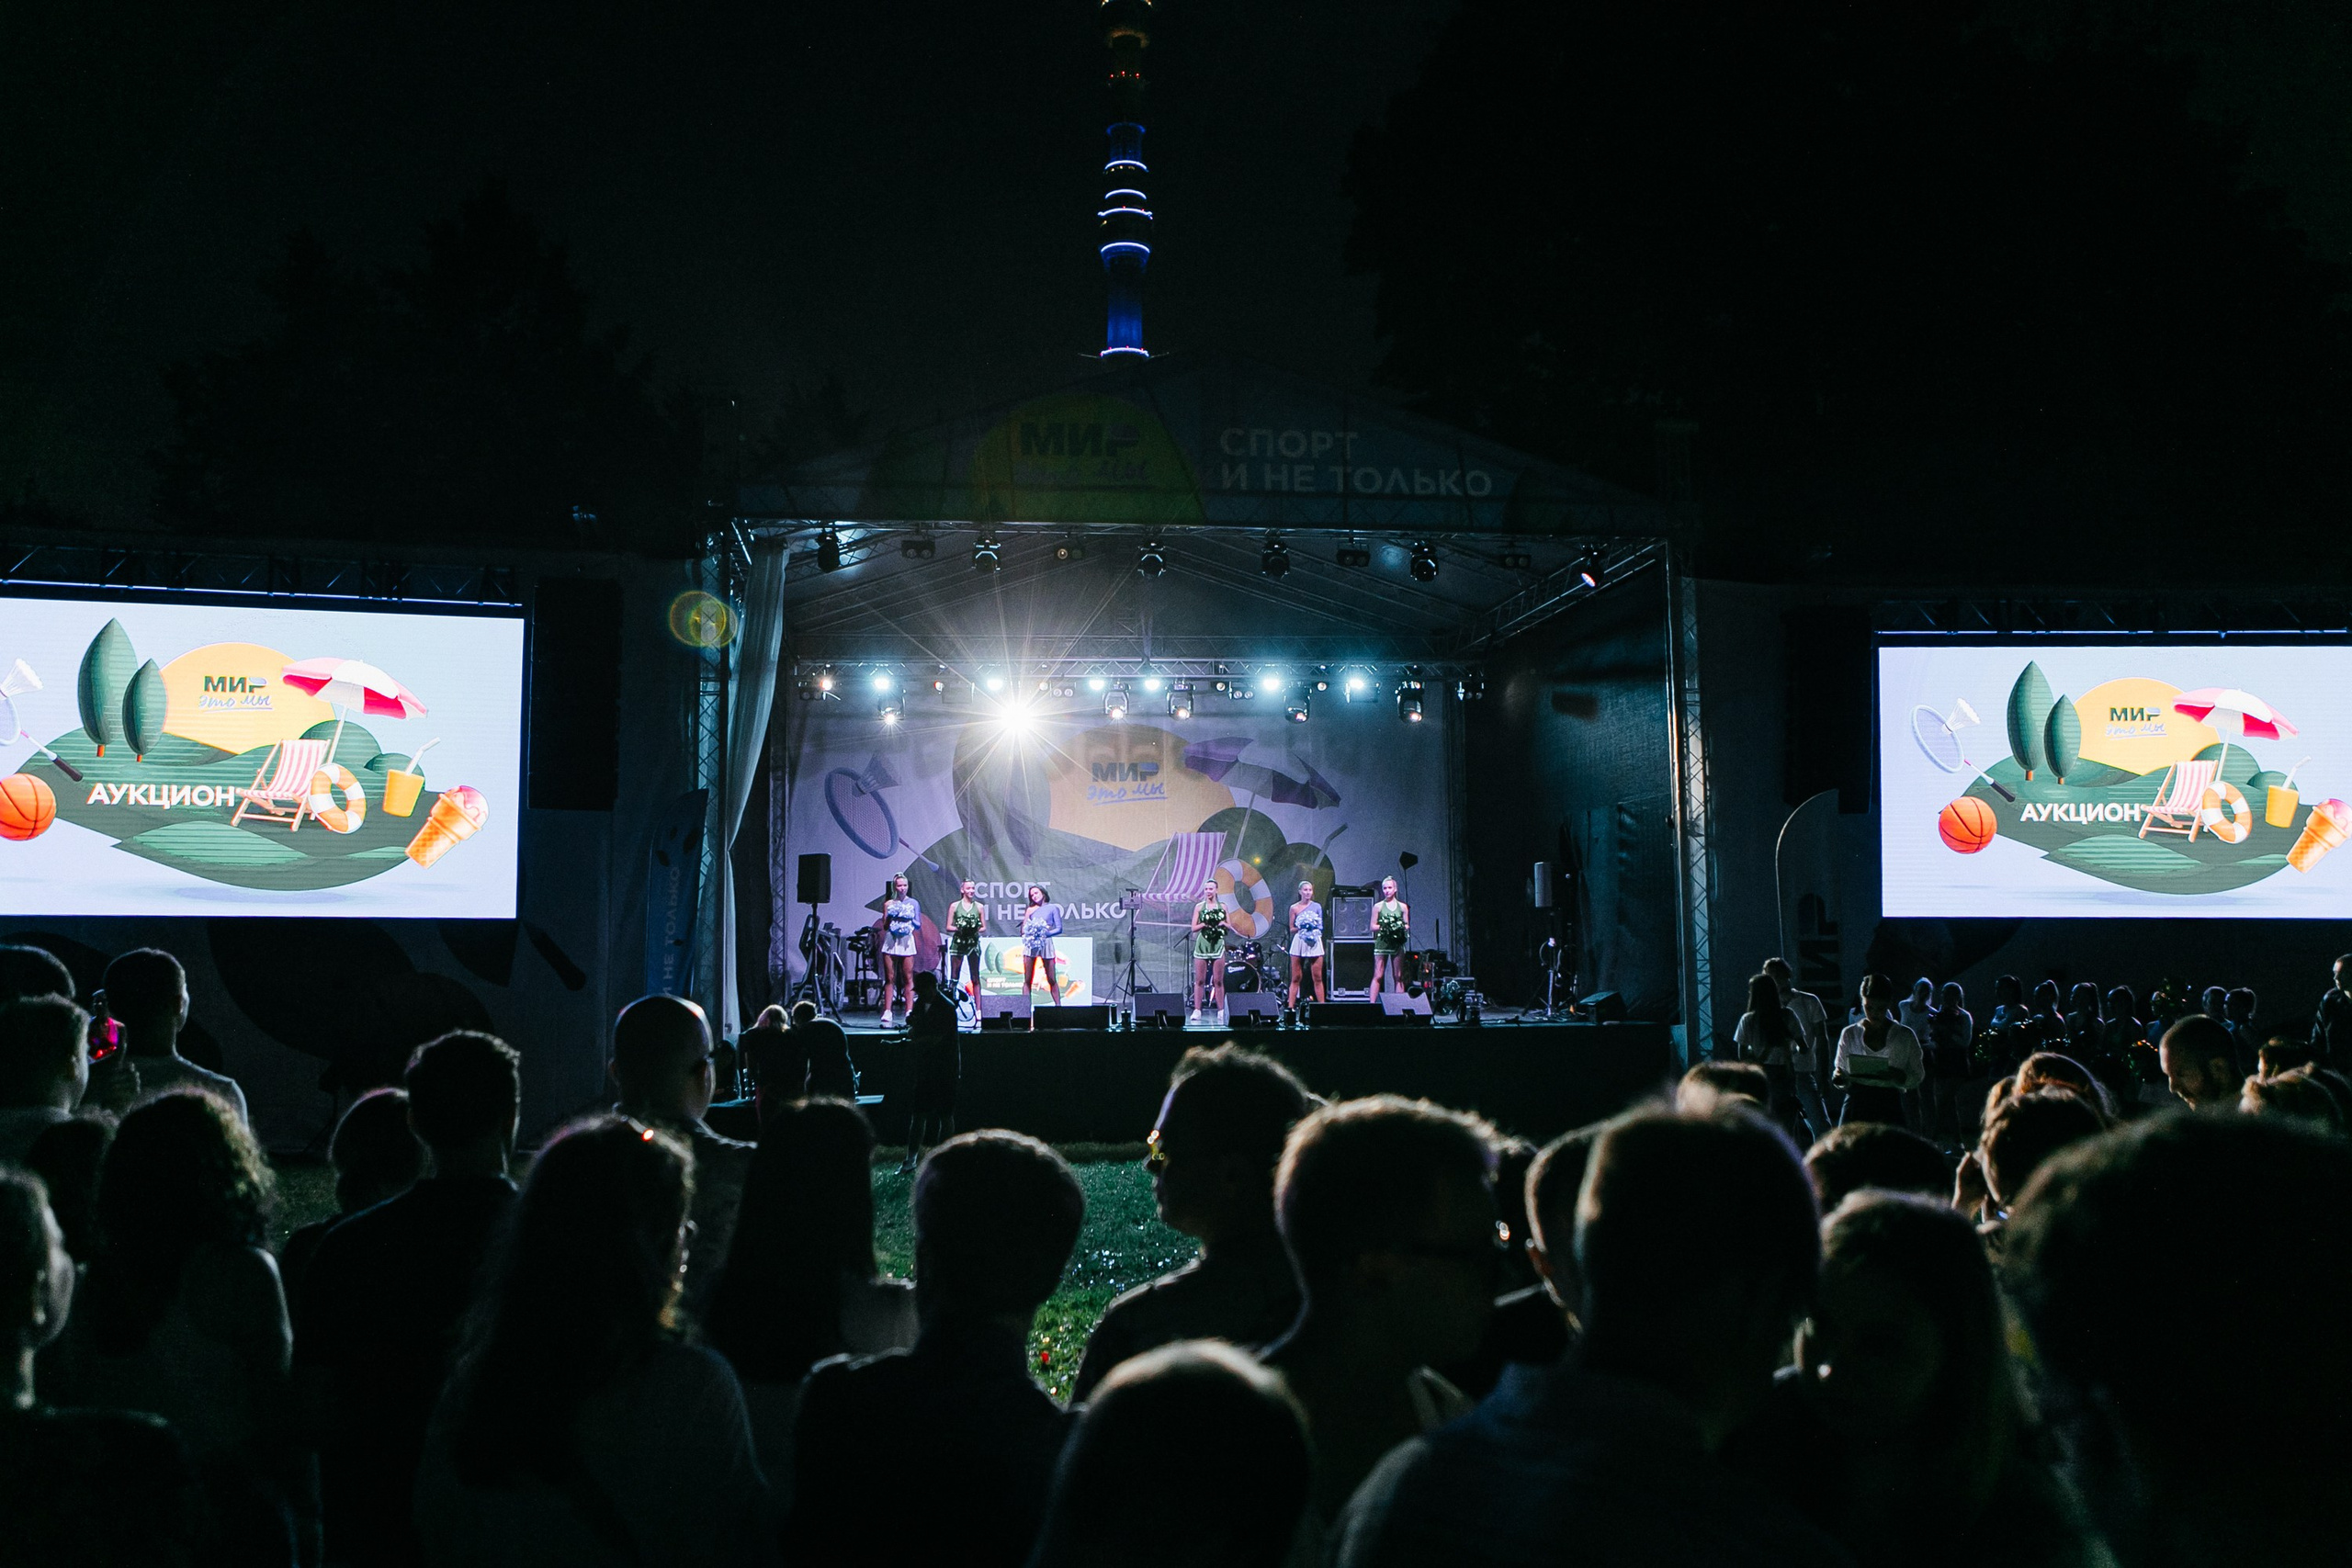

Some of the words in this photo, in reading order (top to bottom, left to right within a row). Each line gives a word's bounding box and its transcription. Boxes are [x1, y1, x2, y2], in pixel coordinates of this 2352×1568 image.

[1021, 423, 1139, 457] МИР
[1219, 428, 1358, 460] СПОРТ
[1222, 464, 1248, 491] И
[1264, 465, 1316, 492] НЕ
[1329, 467, 1492, 497] ТОЛЬКО
[204, 676, 266, 693] МИР
[2109, 707, 2161, 722] МИР
[1091, 761, 1159, 782] МИР
[86, 783, 235, 810] АУКЦИОН
[2020, 803, 2141, 825] АУКЦИОН
[997, 903, 1027, 920] НЕ
[1055, 902, 1127, 920] ЛЬКО
